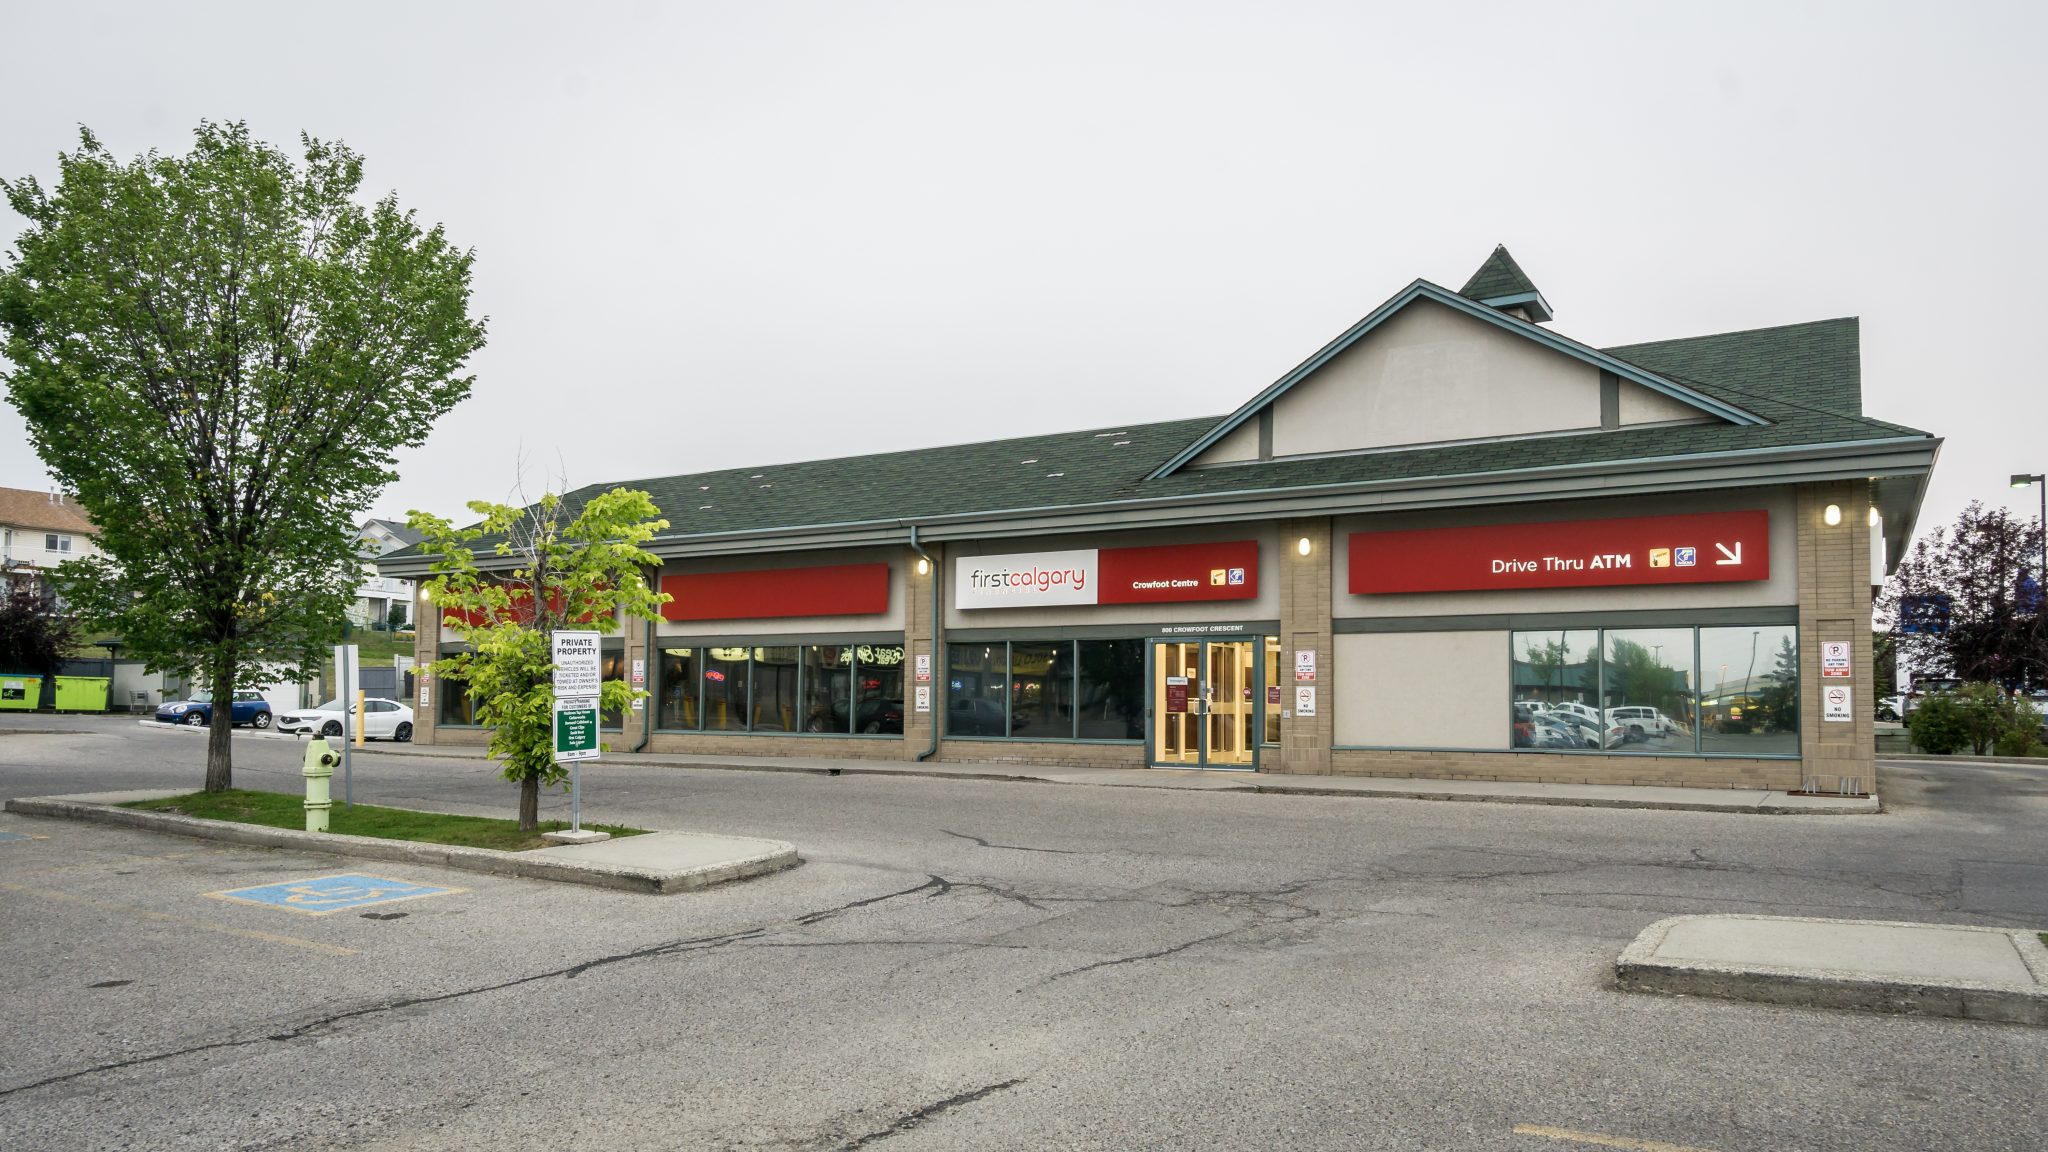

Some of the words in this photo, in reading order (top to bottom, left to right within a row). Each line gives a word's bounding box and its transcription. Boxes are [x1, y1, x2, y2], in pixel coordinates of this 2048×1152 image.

[1492, 559, 1538, 573] Drive
[1543, 556, 1584, 571] Thru
[1590, 553, 1632, 570] ATM
[1132, 580, 1170, 589] Crowfoot
[1171, 579, 1199, 588] Centre
[561, 638, 593, 646] PRIVATE
[557, 647, 597, 655] PROPERTY
